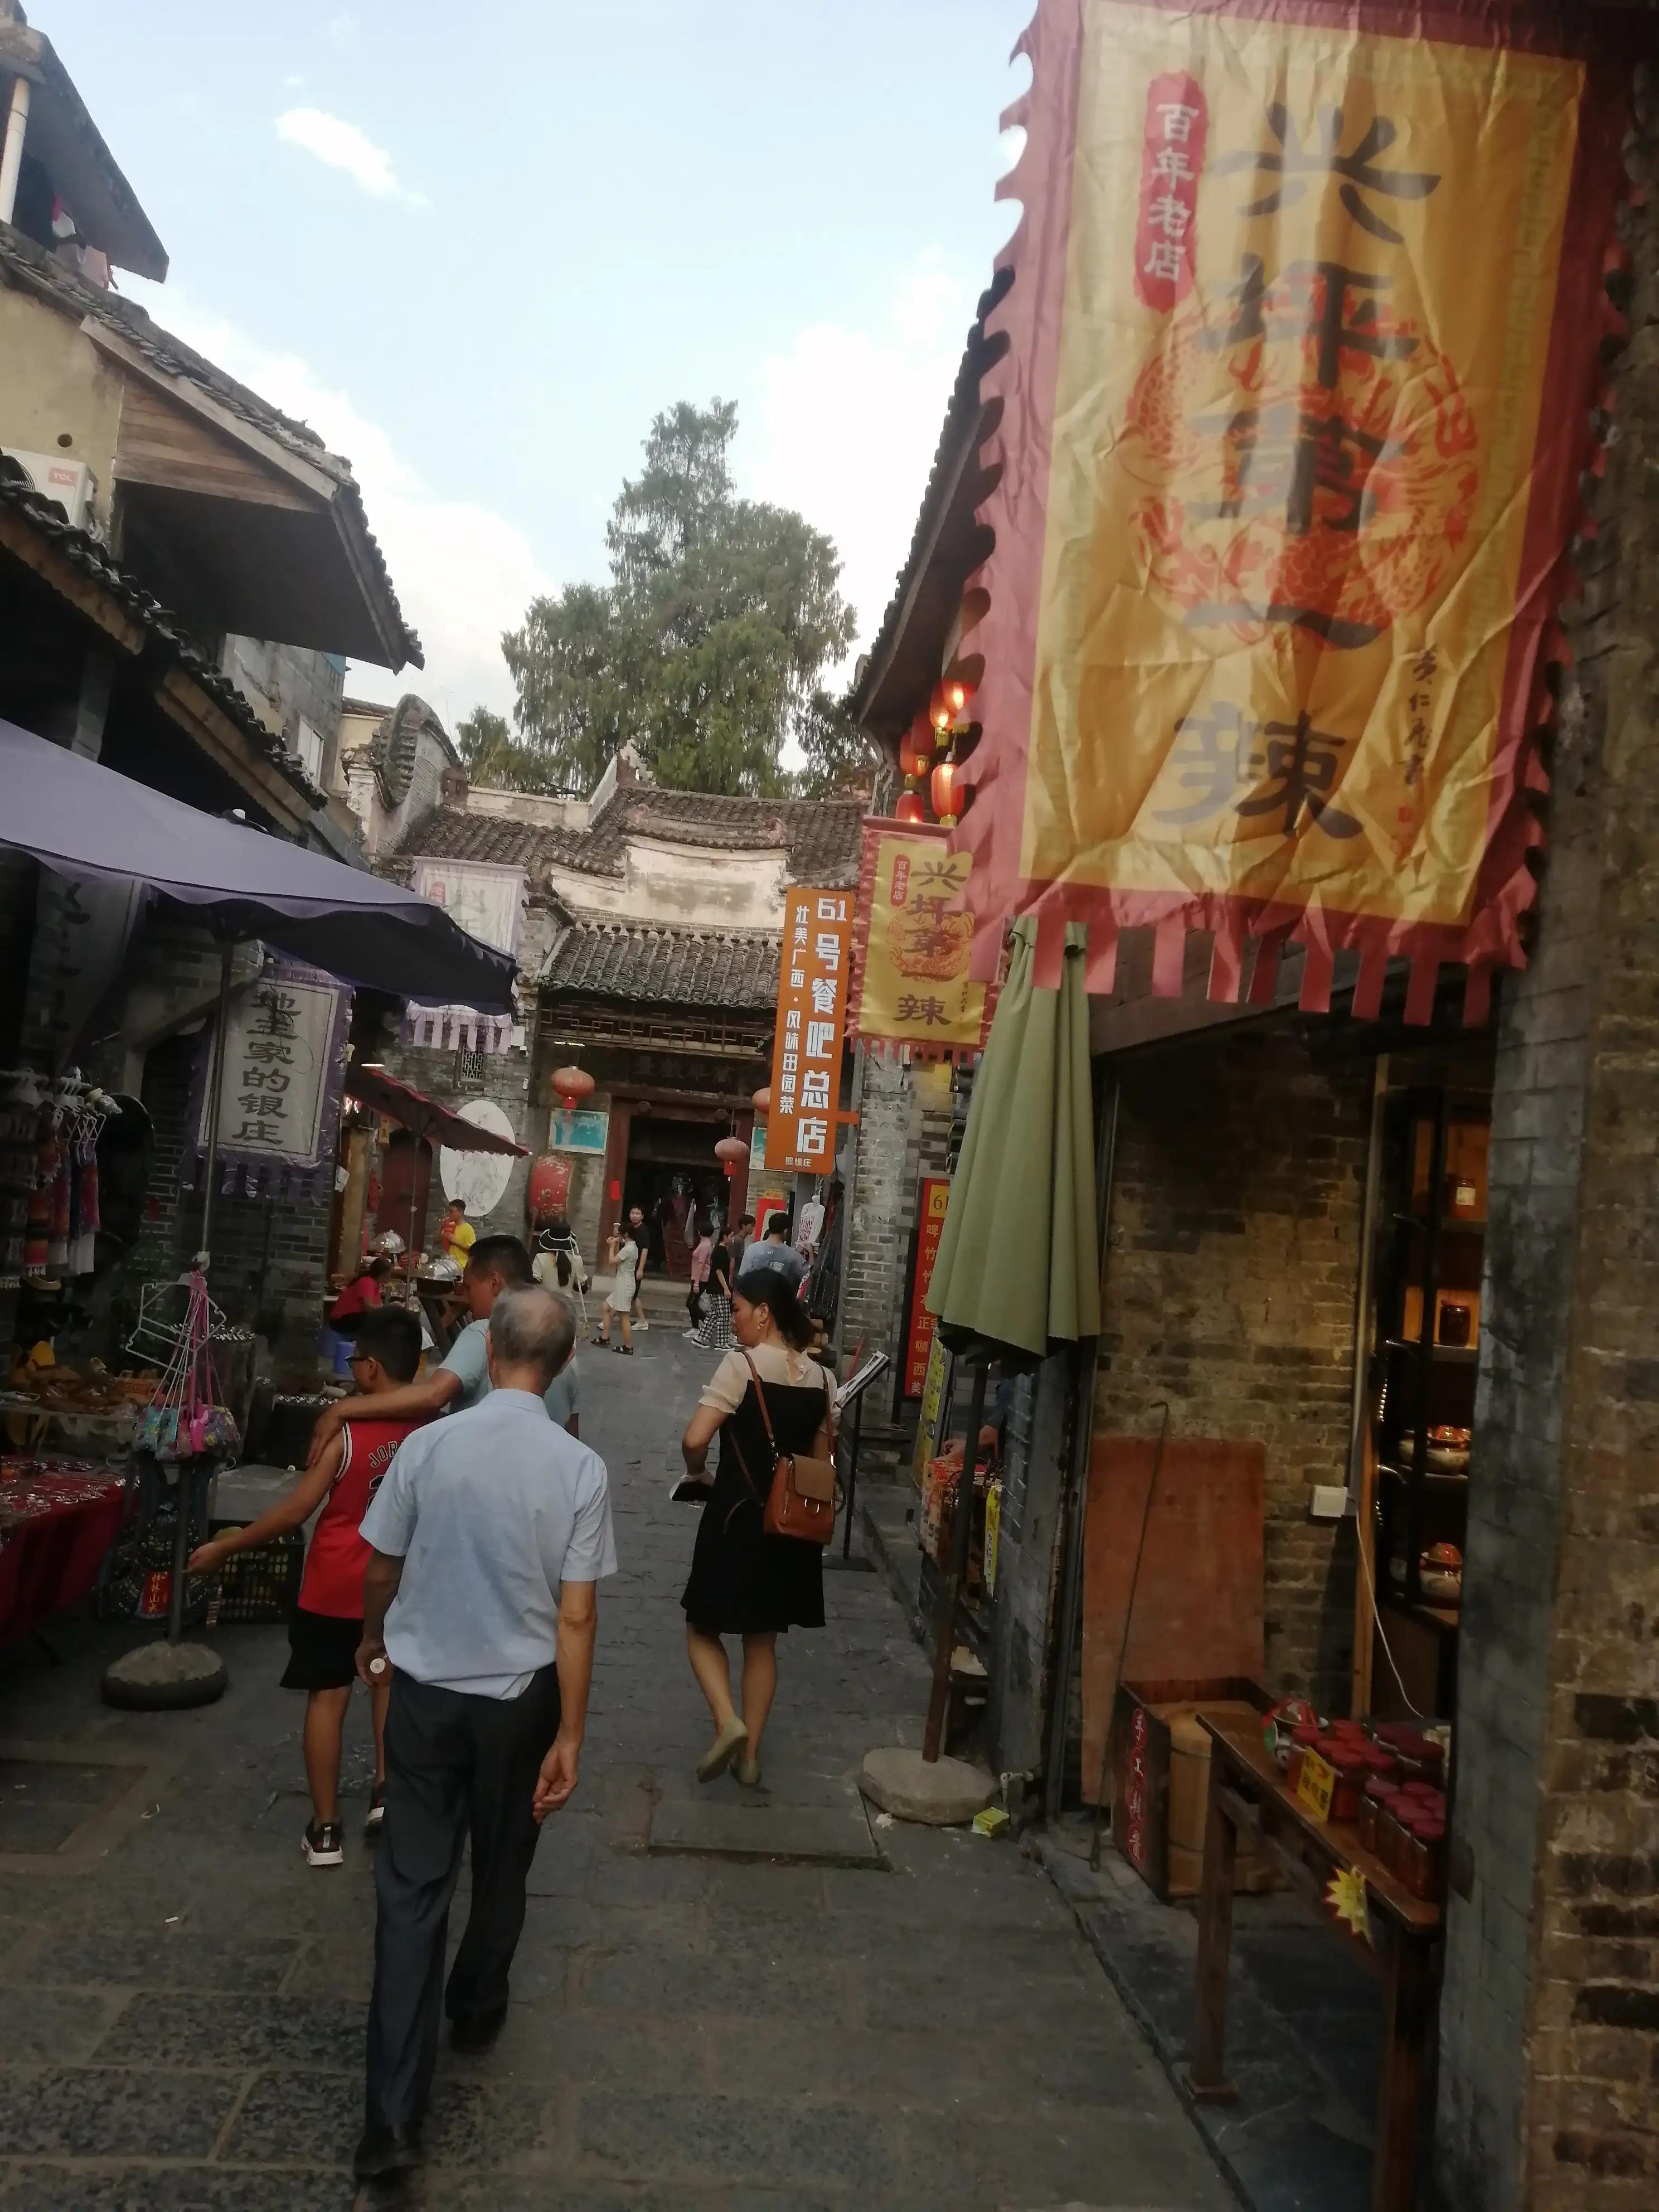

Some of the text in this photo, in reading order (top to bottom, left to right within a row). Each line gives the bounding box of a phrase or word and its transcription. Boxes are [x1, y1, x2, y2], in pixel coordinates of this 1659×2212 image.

[1144, 103, 1199, 283] 百年老店
[54, 472, 73, 482] TCL
[893, 860, 908, 900] 百年老店
[231, 992, 302, 1144] 地主家的银庄
[796, 897, 847, 1154] 61号餐吧总店
[368, 1440, 404, 1468] JOR
